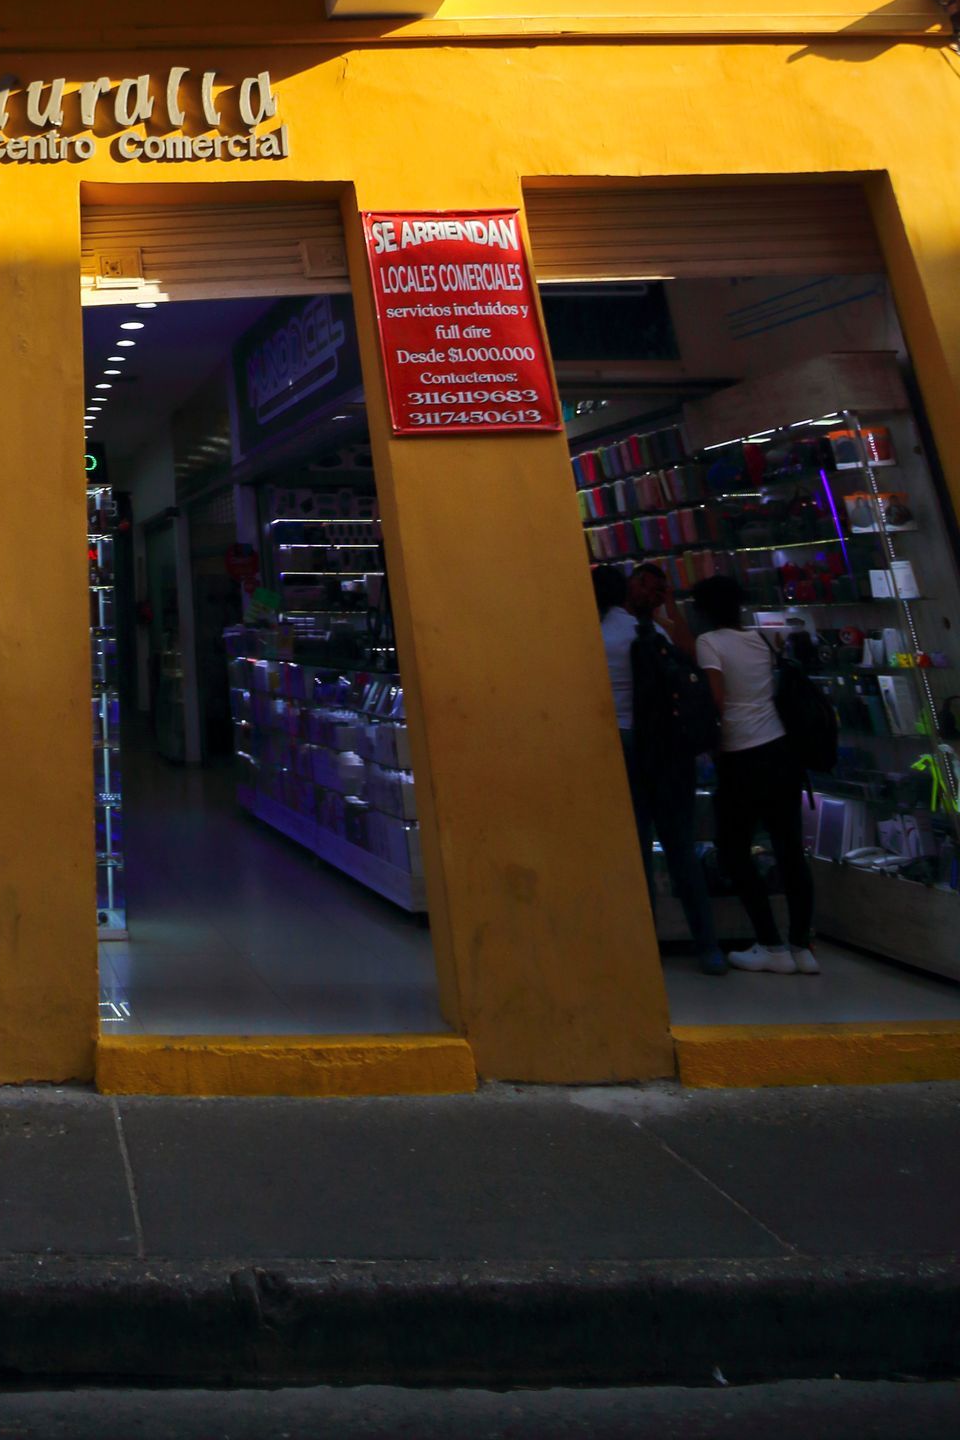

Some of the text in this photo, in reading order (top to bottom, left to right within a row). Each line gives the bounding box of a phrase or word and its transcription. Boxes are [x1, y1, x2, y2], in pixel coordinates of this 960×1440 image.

[118, 124, 289, 160] Comercial
[372, 218, 519, 253] SE ARRIENDAN
[380, 263, 524, 294] LOCALES COMERCIALES
[386, 301, 529, 318] servicios incluidos y
[435, 325, 491, 339] full aire
[396, 346, 535, 363] Desde $1.000.000
[420, 372, 518, 384] Contactenos:
[407, 389, 539, 405] 3116119683
[408, 409, 542, 425] 3117450613
